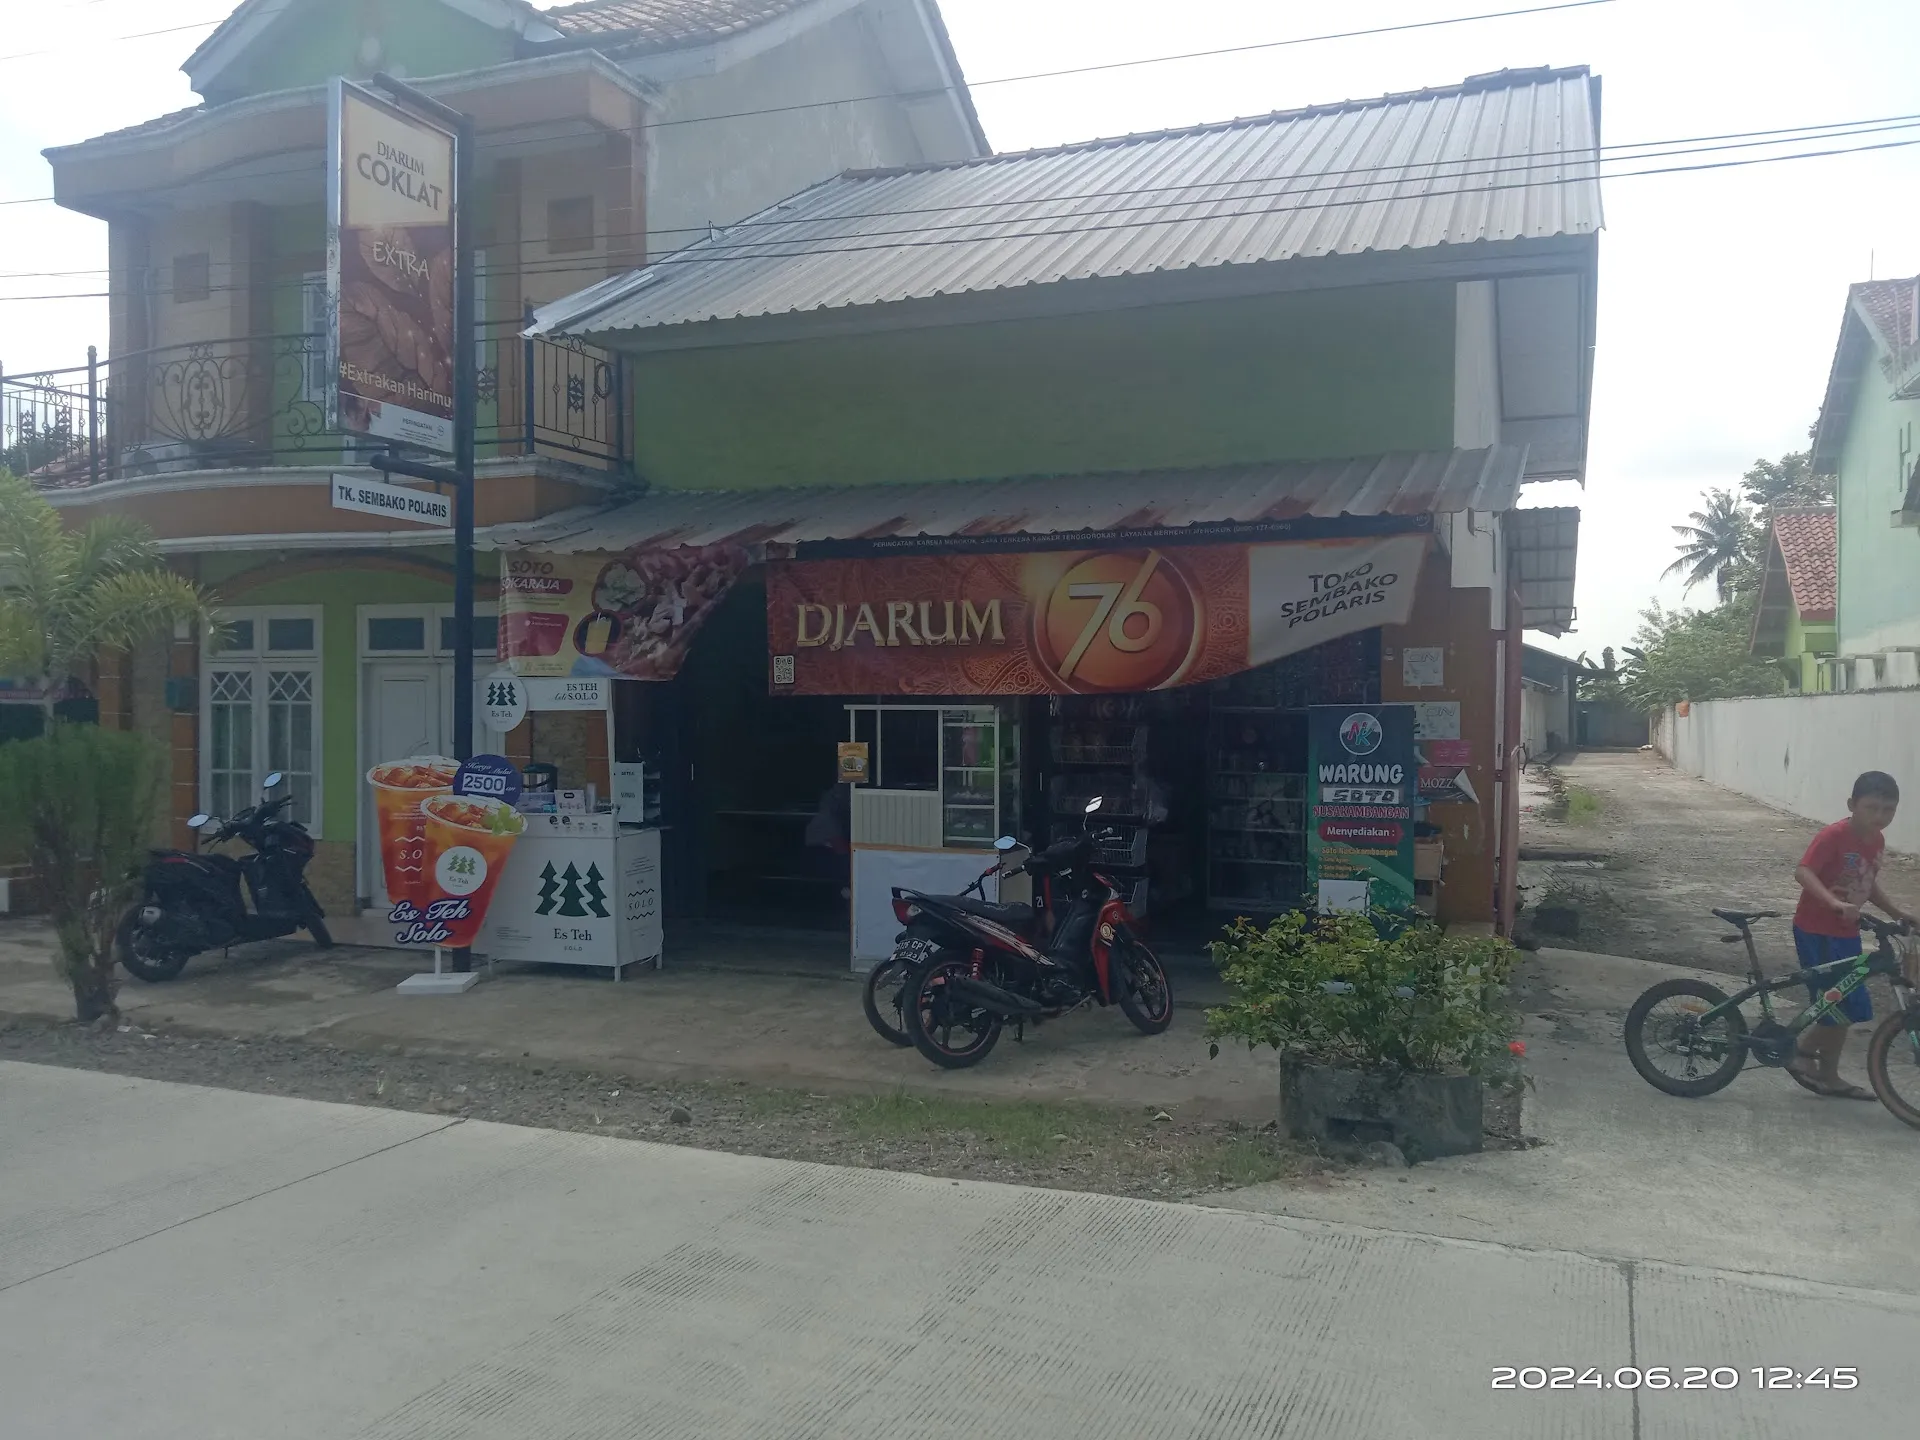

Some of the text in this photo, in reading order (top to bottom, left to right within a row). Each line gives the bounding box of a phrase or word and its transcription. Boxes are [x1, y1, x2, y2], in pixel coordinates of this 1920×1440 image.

[357, 152, 443, 211] COKLAT
[373, 240, 430, 281] EXTRA
[339, 360, 452, 408] #Extrakan Harimu
[338, 485, 447, 518] TK. SEMBAKO POLARIS
[1032, 534, 1061, 542] KANKER
[509, 560, 554, 575] SOTO
[1308, 562, 1374, 593] TOKO
[1280, 573, 1398, 619] SEMBAKO
[1057, 548, 1163, 683] 76
[1287, 590, 1386, 629] POLARIS
[796, 599, 1006, 651] DJARUM
[566, 682, 598, 692] ES TEH
[491, 710, 513, 718] Es Teh
[465, 762, 492, 772] Harga
[1318, 763, 1404, 784] WARUNG
[464, 775, 504, 791] 2500
[1420, 777, 1457, 789] MOZZ
[1332, 789, 1395, 803] SOTO
[1313, 805, 1410, 820] NUSAKAMBANGAN
[1327, 826, 1390, 838] Menyediakan
[390, 901, 470, 922] Es Teh
[397, 922, 451, 943] Solo
[554, 928, 592, 941] Es Teh
